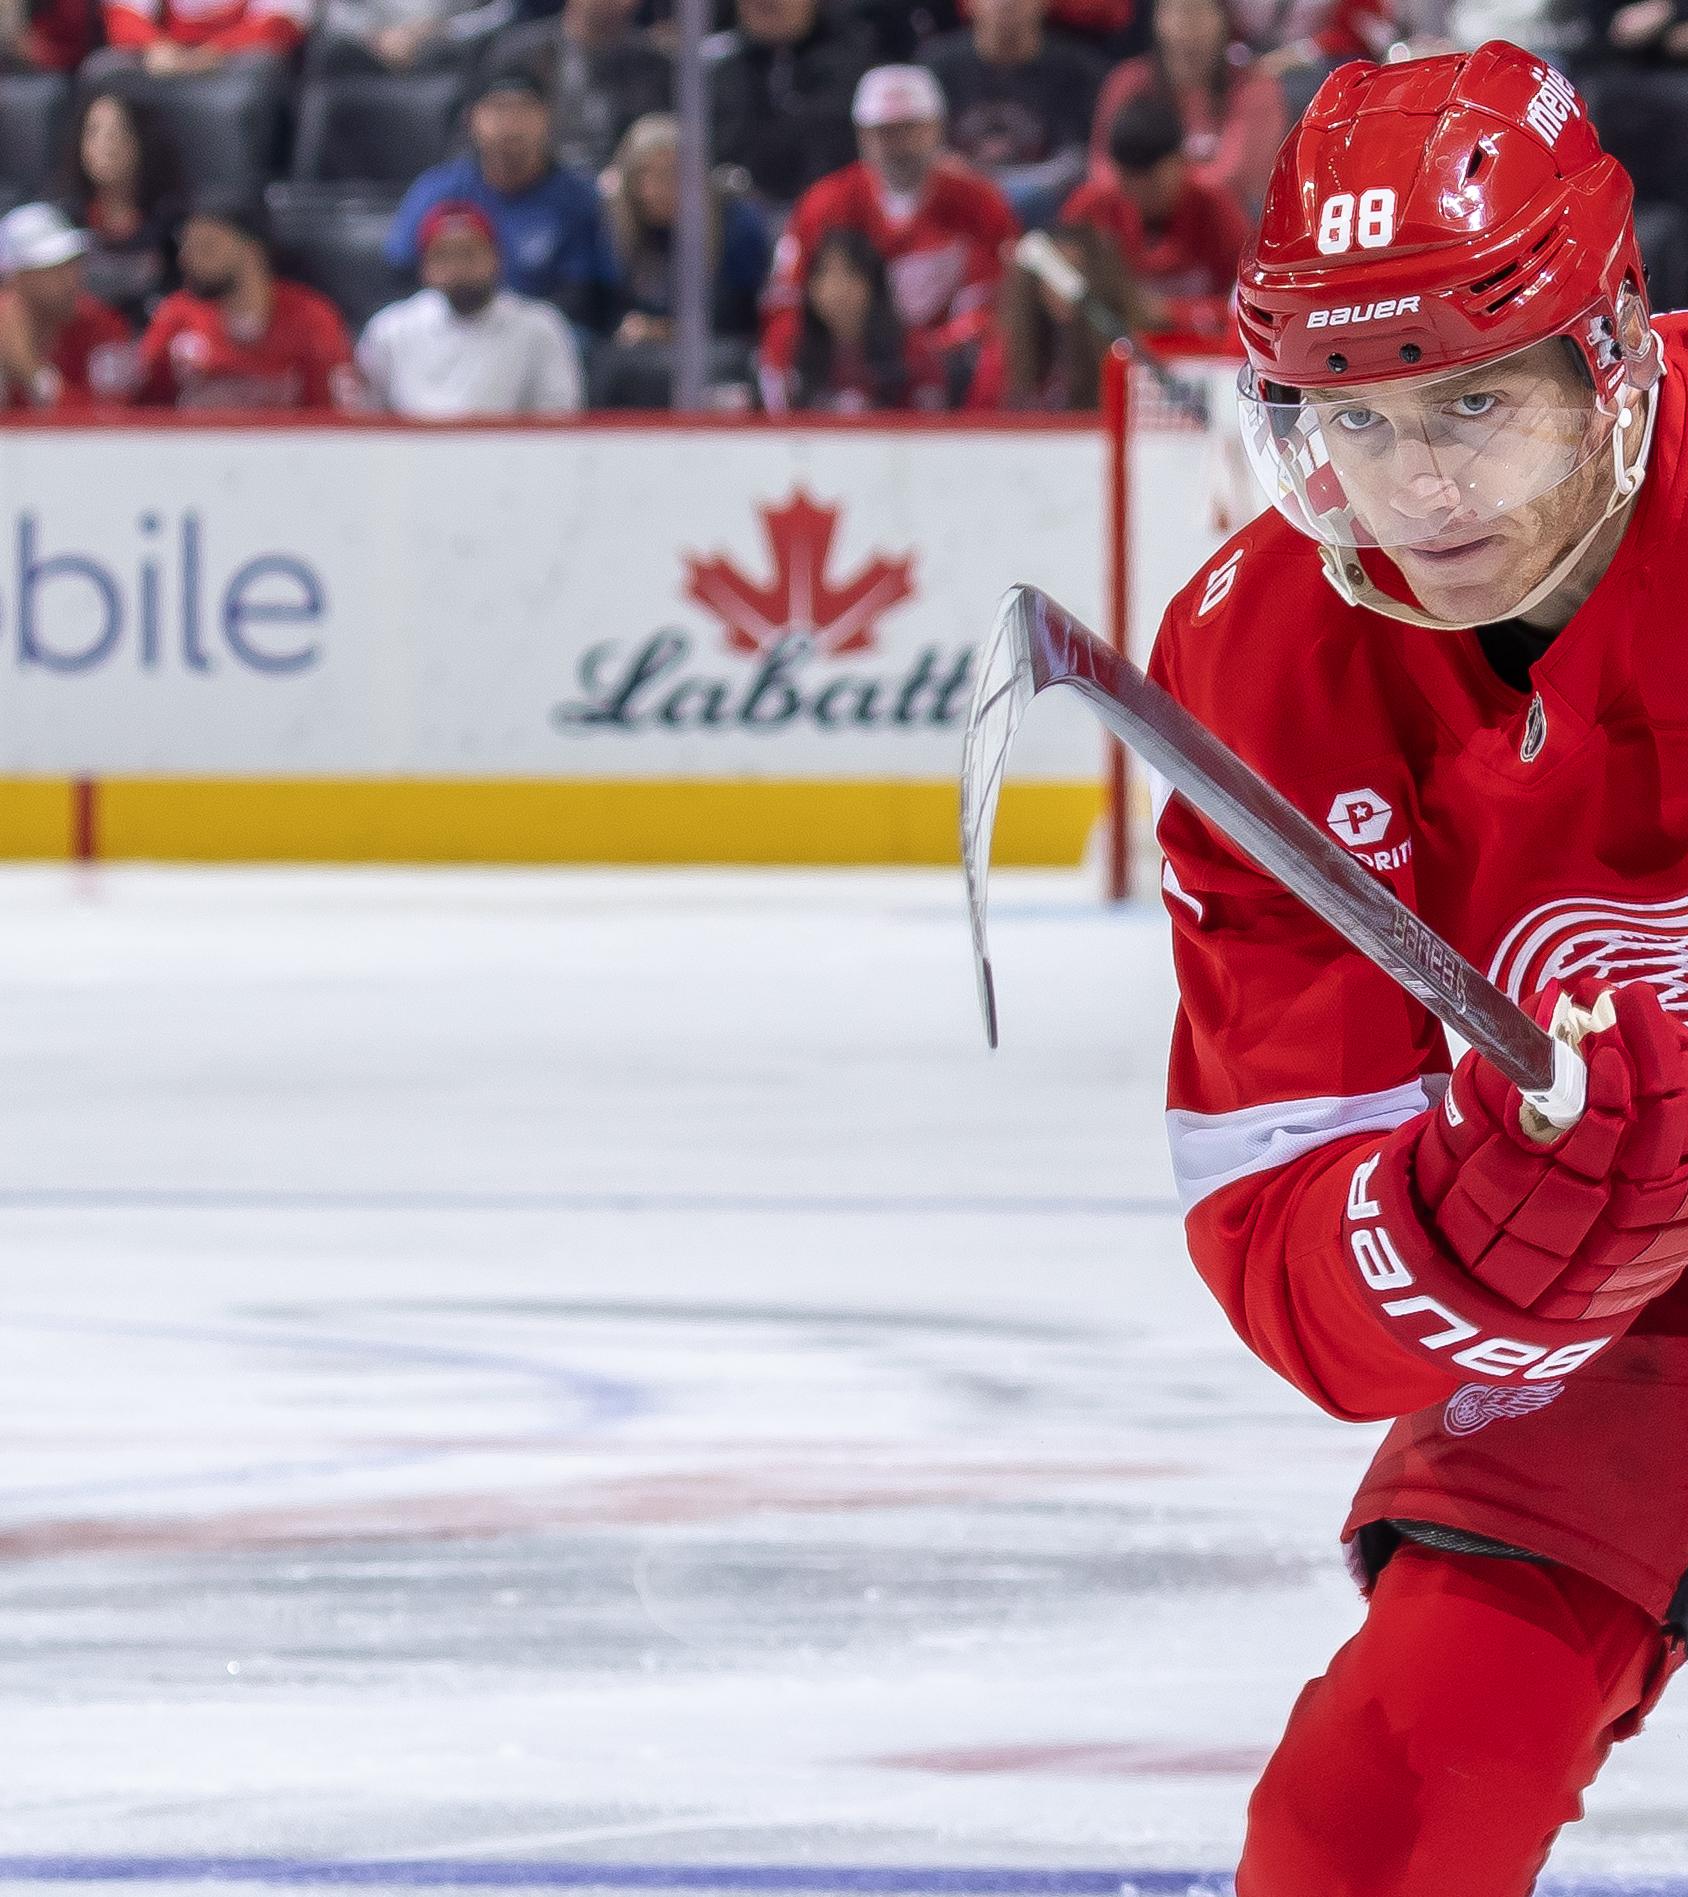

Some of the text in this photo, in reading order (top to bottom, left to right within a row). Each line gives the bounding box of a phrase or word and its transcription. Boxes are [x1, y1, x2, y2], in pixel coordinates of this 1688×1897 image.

[1317, 188, 1397, 255] 88
[0, 510, 326, 674] bile
[554, 628, 979, 733] Labatt
